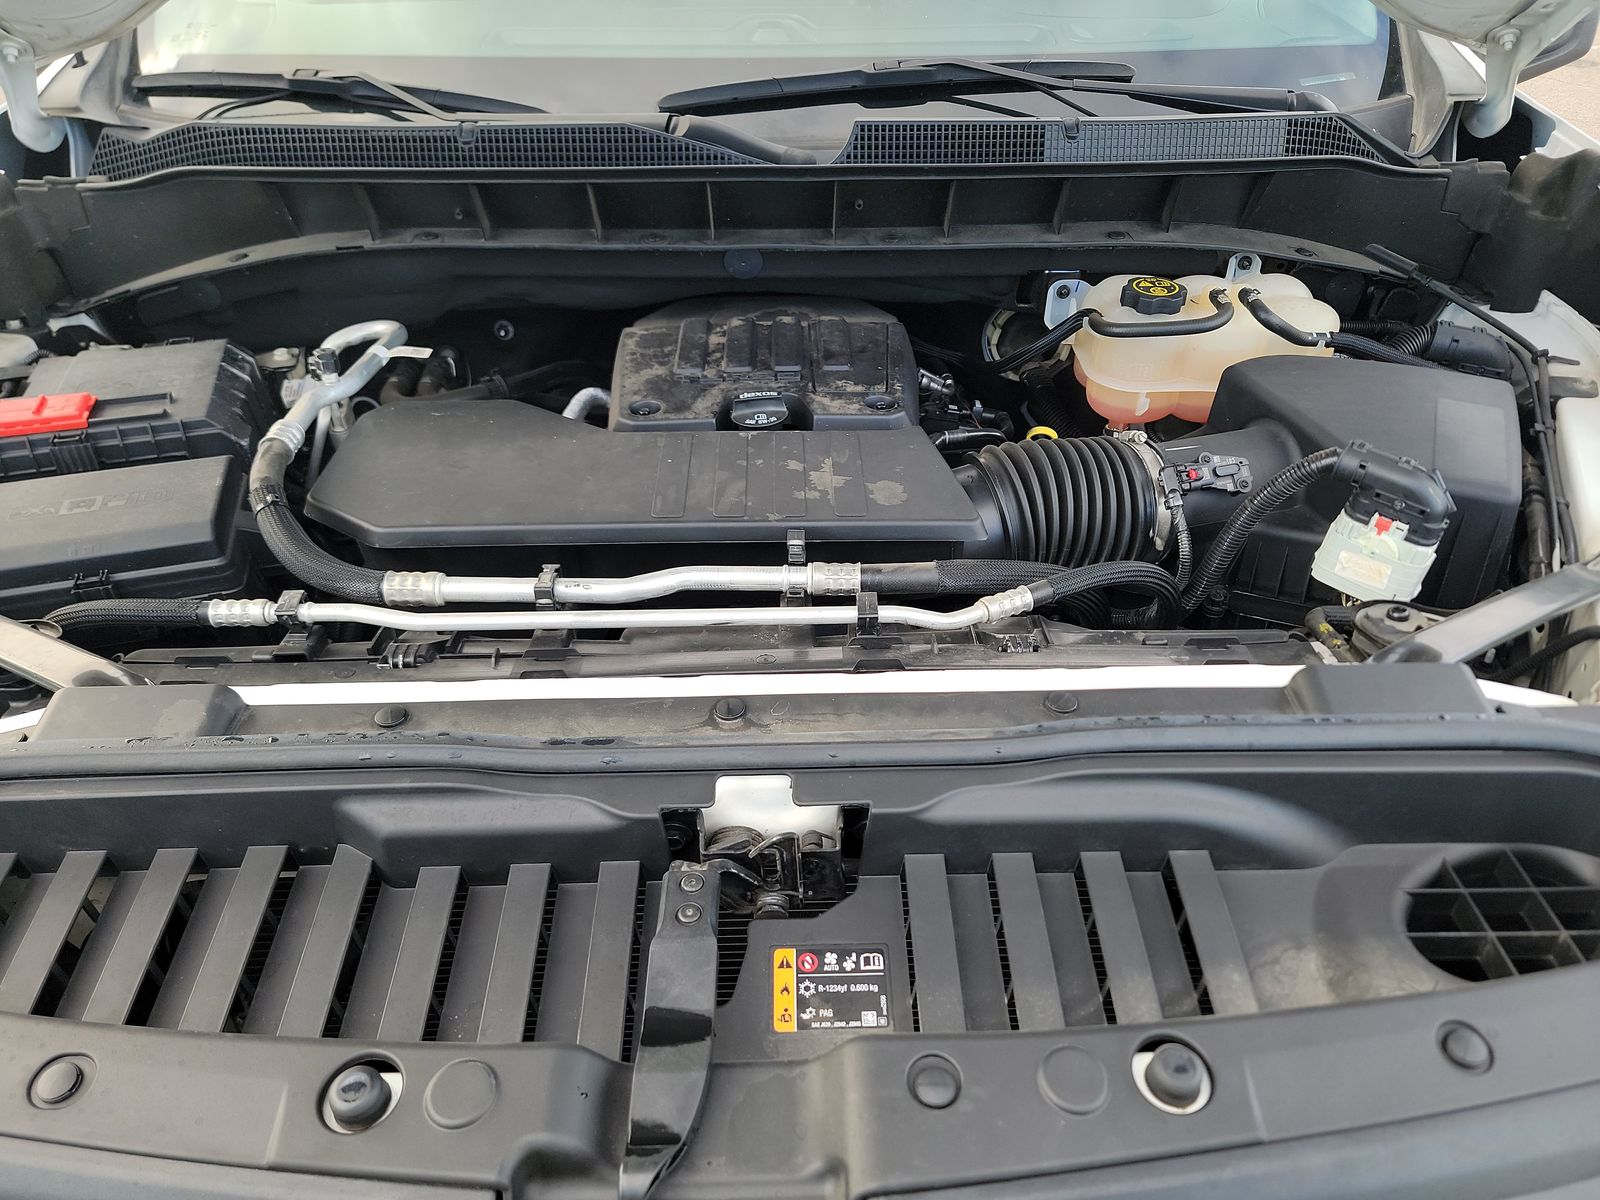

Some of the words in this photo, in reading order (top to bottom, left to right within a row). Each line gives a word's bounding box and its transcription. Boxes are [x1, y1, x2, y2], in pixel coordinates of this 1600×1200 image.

[740, 391, 778, 399] dexos
[823, 964, 840, 972] AUTO
[818, 984, 848, 994] R-1234yf
[870, 983, 879, 993] kg
[819, 1008, 834, 1018] PAG
